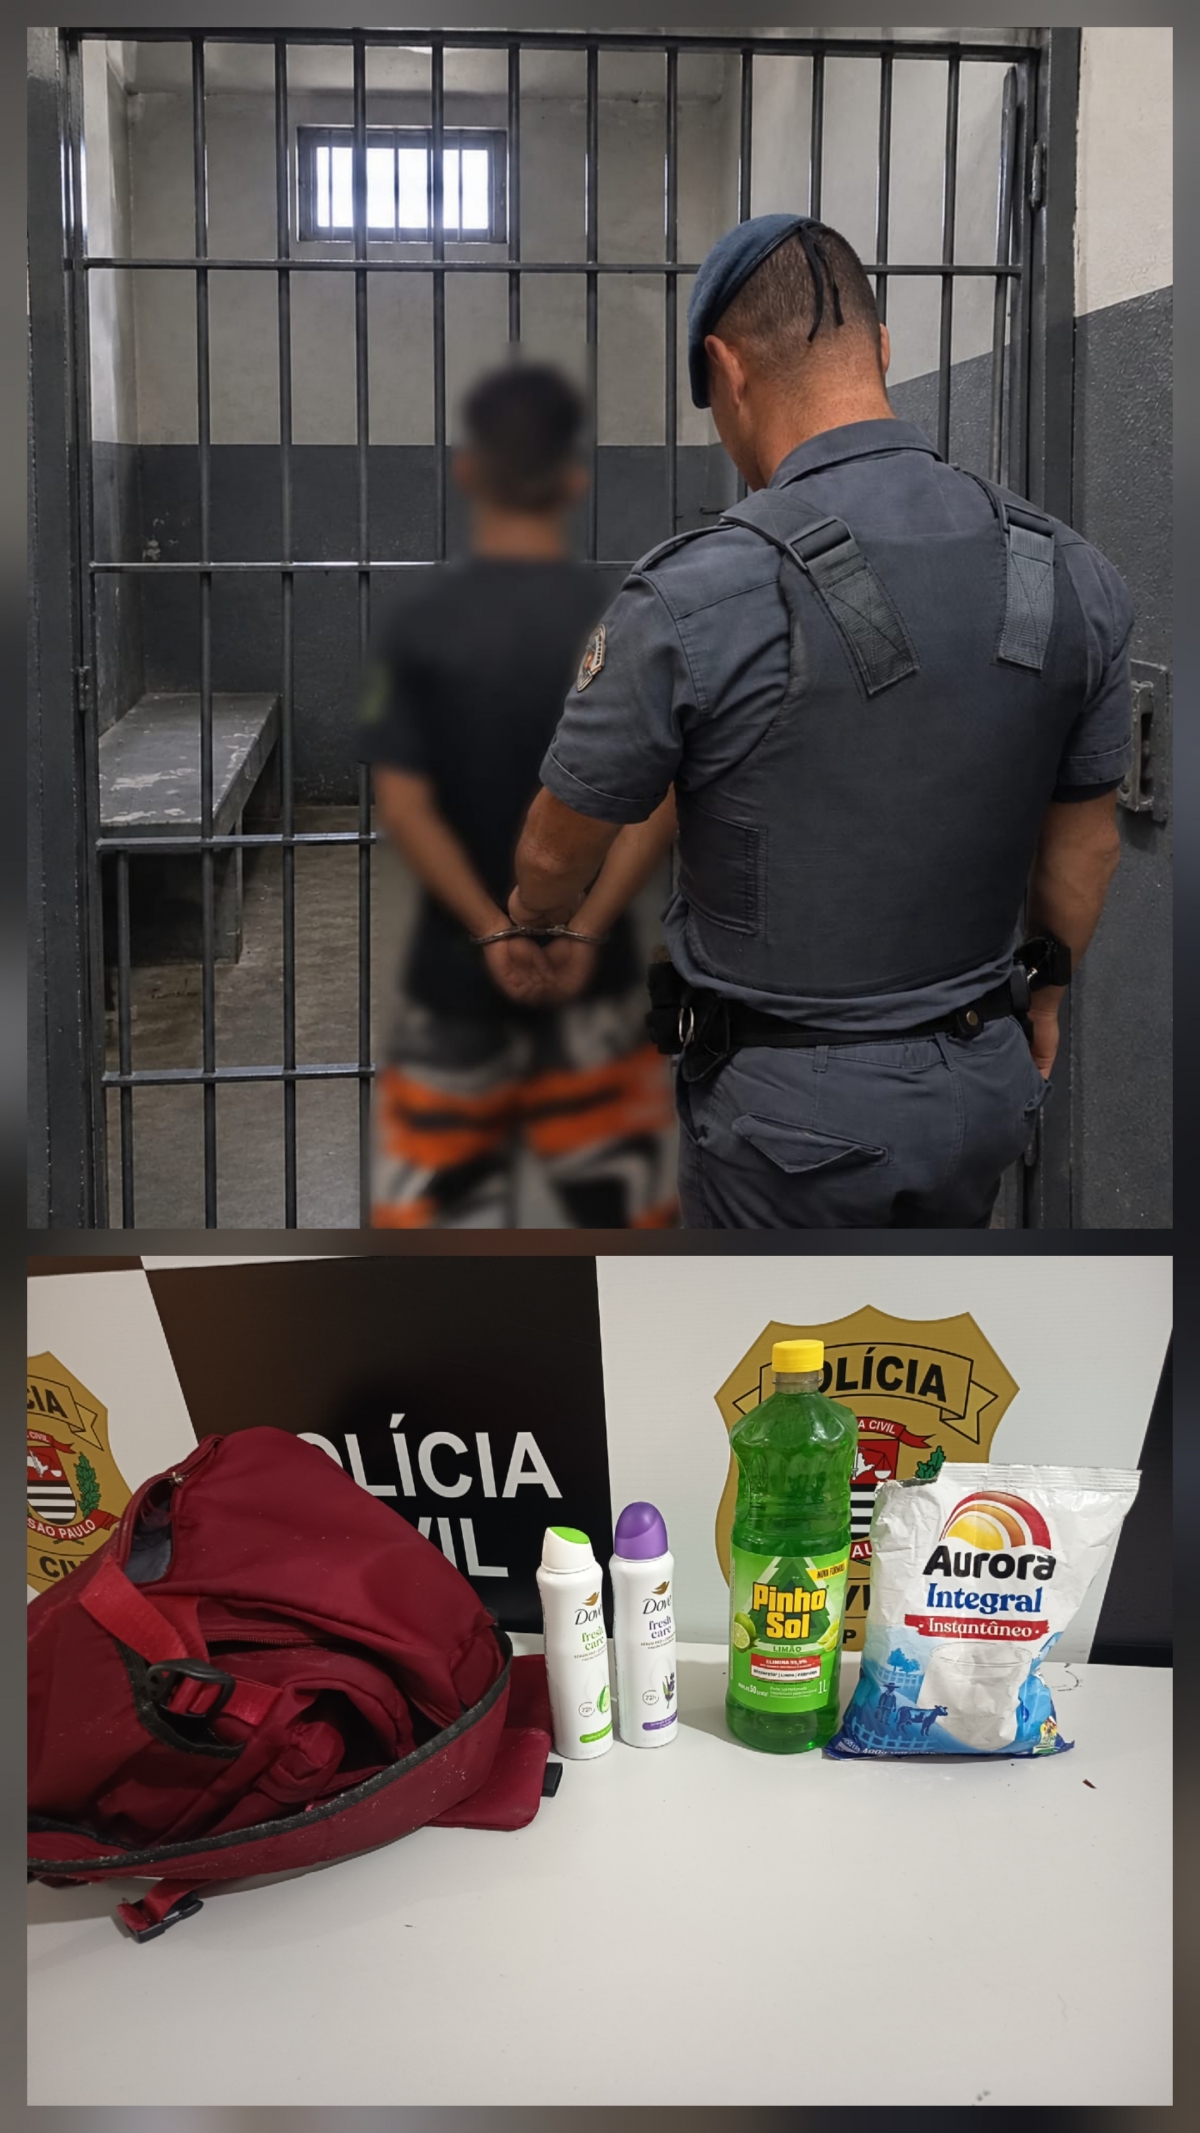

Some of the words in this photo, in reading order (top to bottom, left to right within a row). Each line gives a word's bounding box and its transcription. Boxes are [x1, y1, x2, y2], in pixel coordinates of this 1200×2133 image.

[818, 1347, 946, 1403] LÍCIA
[869, 1419, 896, 1435] CIVIL
[296, 1413, 563, 1499] LÍCIA
[58, 1519, 96, 1539] PAULO
[922, 1545, 1056, 1581] Aurora
[752, 1582, 827, 1613] Pinho
[926, 1583, 1043, 1615] Integral
[648, 1615, 672, 1631] fresh
[765, 1611, 811, 1640] Sol
[928, 1617, 1032, 1637] Instantâneo
[773, 1645, 802, 1653] LIMÃO
[749, 1684, 757, 1693] 50
